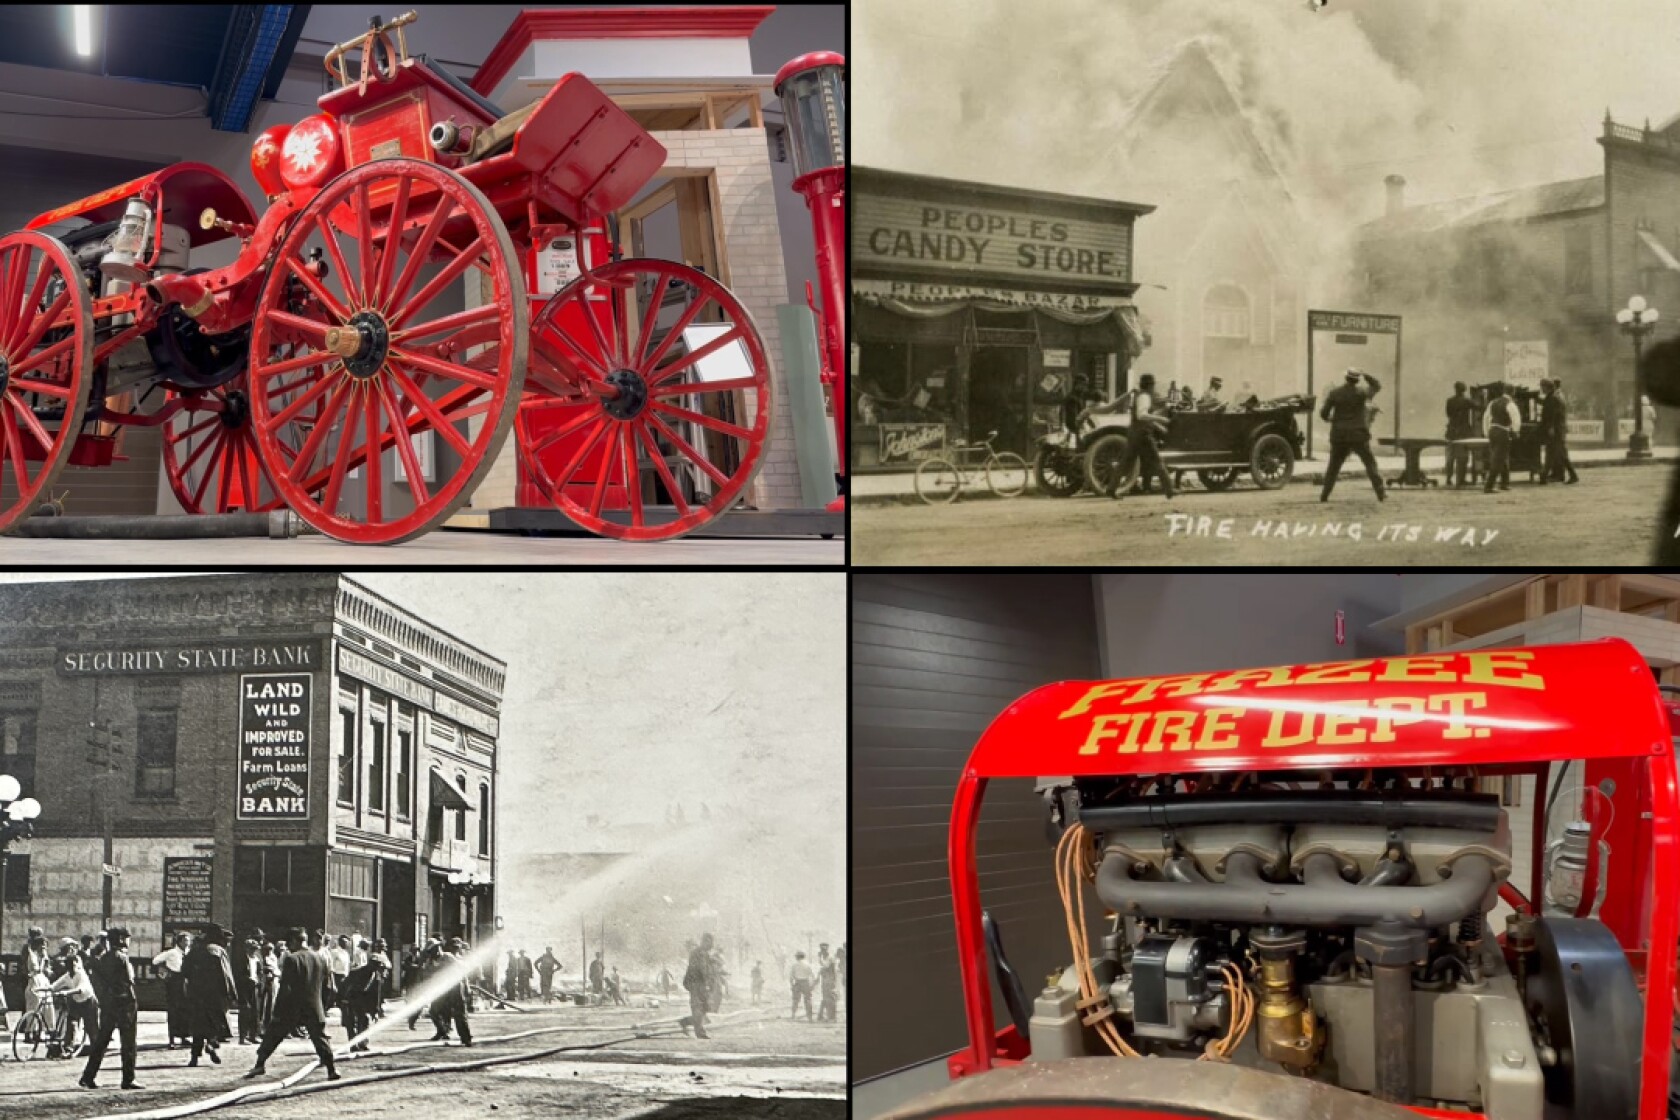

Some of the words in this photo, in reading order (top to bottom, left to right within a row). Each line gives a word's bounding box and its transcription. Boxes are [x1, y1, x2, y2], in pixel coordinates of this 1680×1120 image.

[920, 206, 1070, 243] PEOPLES
[868, 227, 990, 265] CANDY
[1332, 315, 1399, 330] FURNITURE
[64, 649, 167, 672] SECURITY
[176, 646, 245, 669] STATE
[252, 645, 312, 666] BANK
[245, 682, 304, 699] LAND
[1057, 651, 1546, 720] FRAZEE
[254, 702, 301, 717] WILD
[265, 719, 288, 728] AND
[1078, 710, 1240, 755] FIRE
[1260, 691, 1491, 748] DEPT.
[245, 730, 305, 744] IMPROVED
[251, 746, 273, 757] FOR
[274, 746, 305, 757] SALE.
[243, 760, 274, 773] Farm
[276, 760, 307, 773] Loans
[245, 774, 282, 794] Security
[242, 797, 306, 813] BANK
